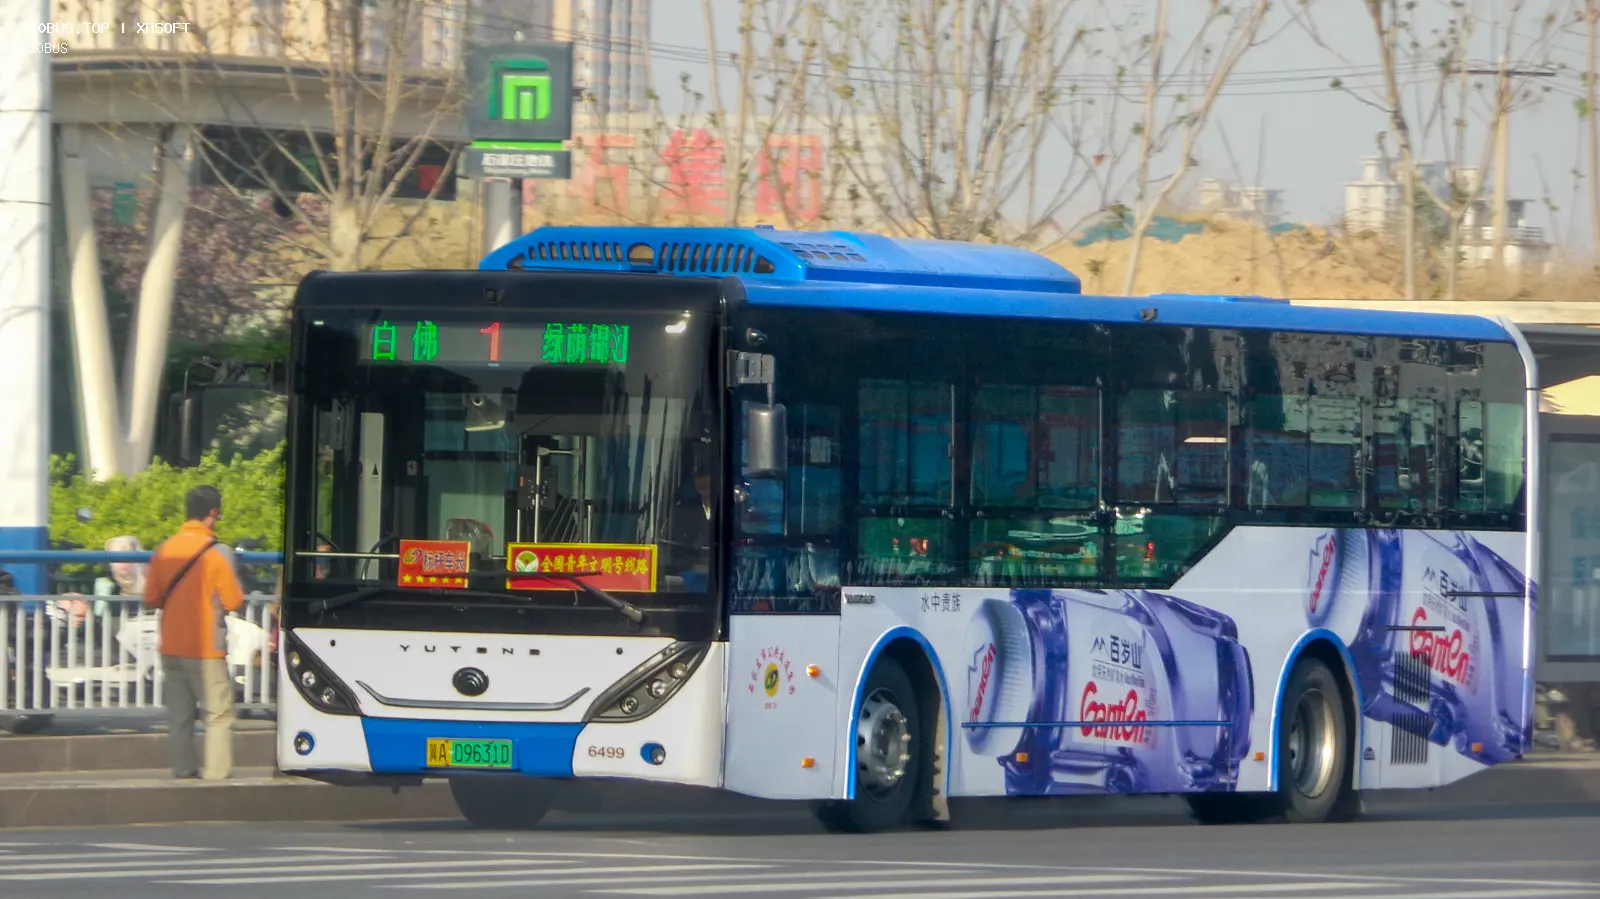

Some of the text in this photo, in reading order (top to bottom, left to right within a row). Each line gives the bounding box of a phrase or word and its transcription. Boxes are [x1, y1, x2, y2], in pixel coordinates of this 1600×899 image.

[372, 321, 439, 361] 白佛
[480, 322, 500, 362] 1
[540, 553, 649, 575] 全国青年文明号线路
[920, 592, 961, 612] 水中贵族
[400, 644, 541, 656] YUTONG
[1110, 634, 1142, 670] 百岁山
[1080, 681, 1146, 744] Ganten
[454, 743, 510, 763] 09631D
[588, 745, 625, 759] 6499
